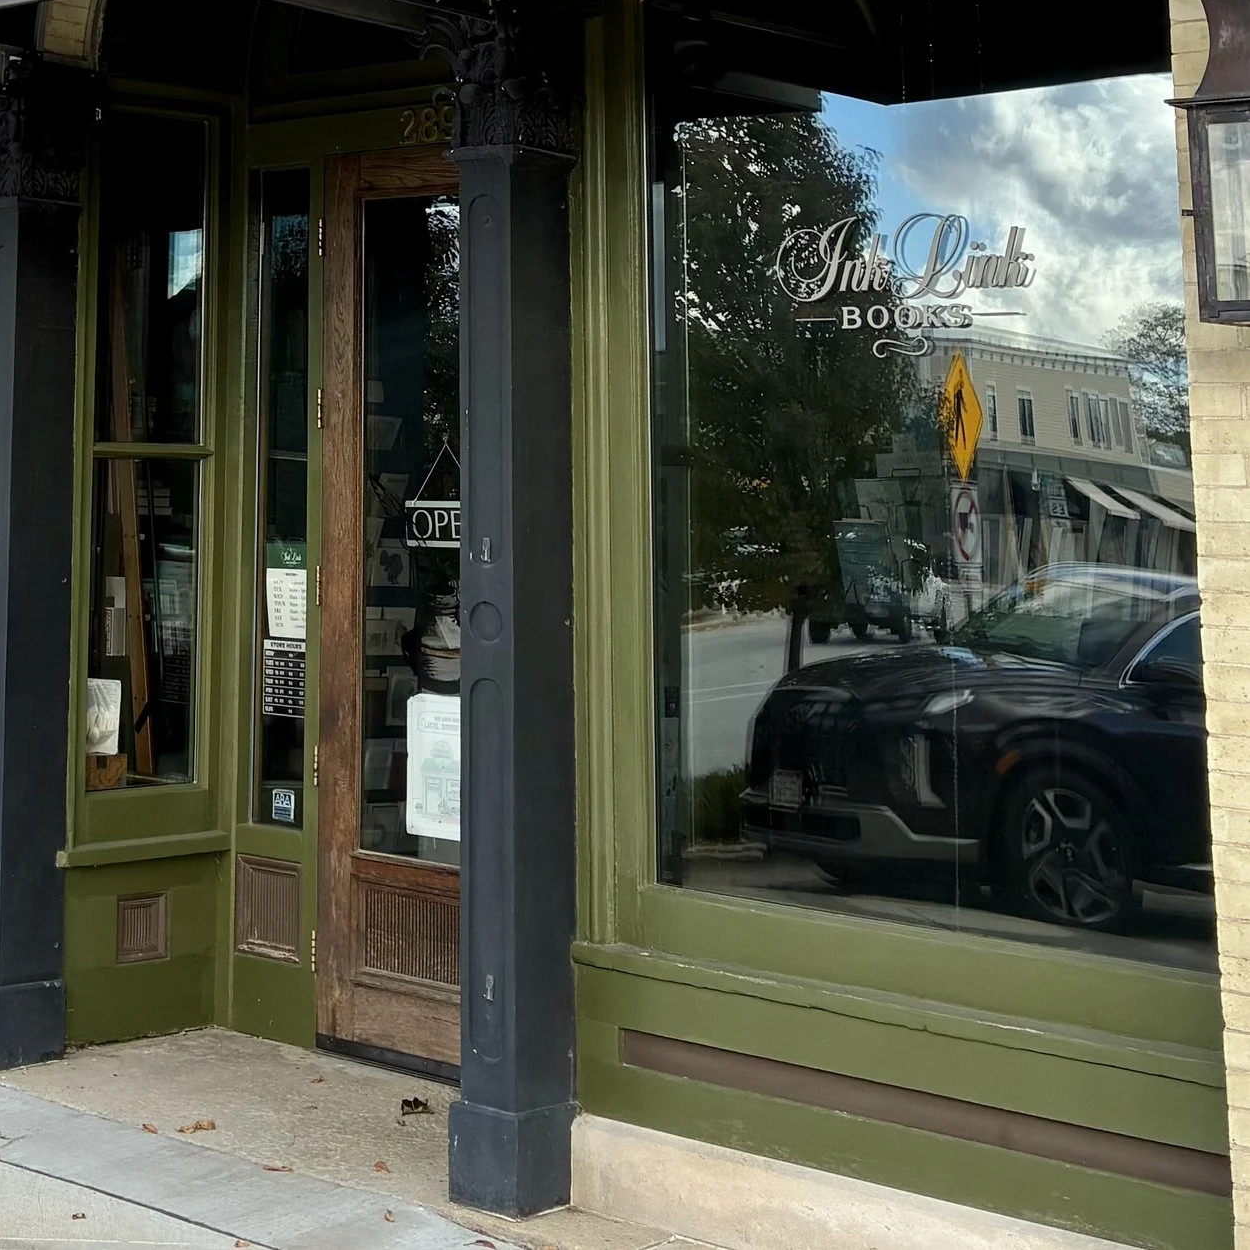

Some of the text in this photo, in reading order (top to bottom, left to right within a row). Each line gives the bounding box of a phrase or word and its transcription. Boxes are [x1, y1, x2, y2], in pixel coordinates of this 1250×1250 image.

[776, 213, 1031, 302] Ink Link
[841, 304, 968, 330] BOOKS
[270, 641, 285, 649] STORE
